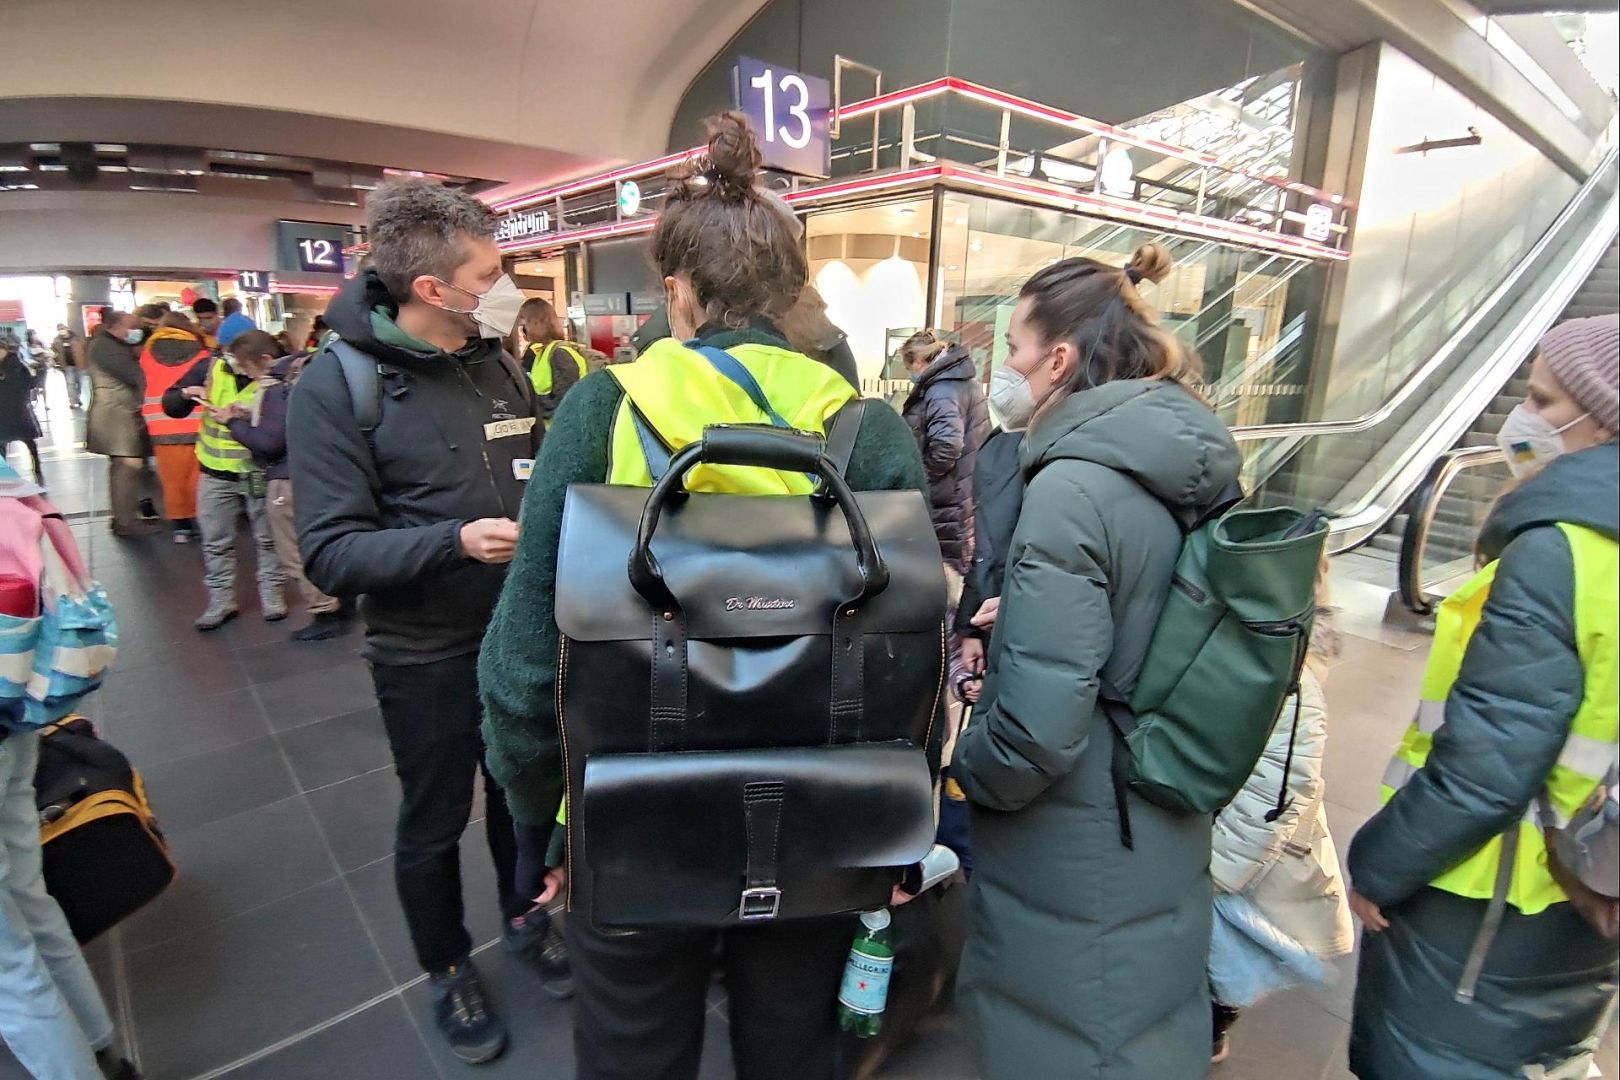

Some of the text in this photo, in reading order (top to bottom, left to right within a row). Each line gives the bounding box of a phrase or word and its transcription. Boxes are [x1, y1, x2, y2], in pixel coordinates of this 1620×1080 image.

[751, 69, 812, 149] 13
[299, 239, 335, 265] 12
[240, 271, 260, 288] 11
